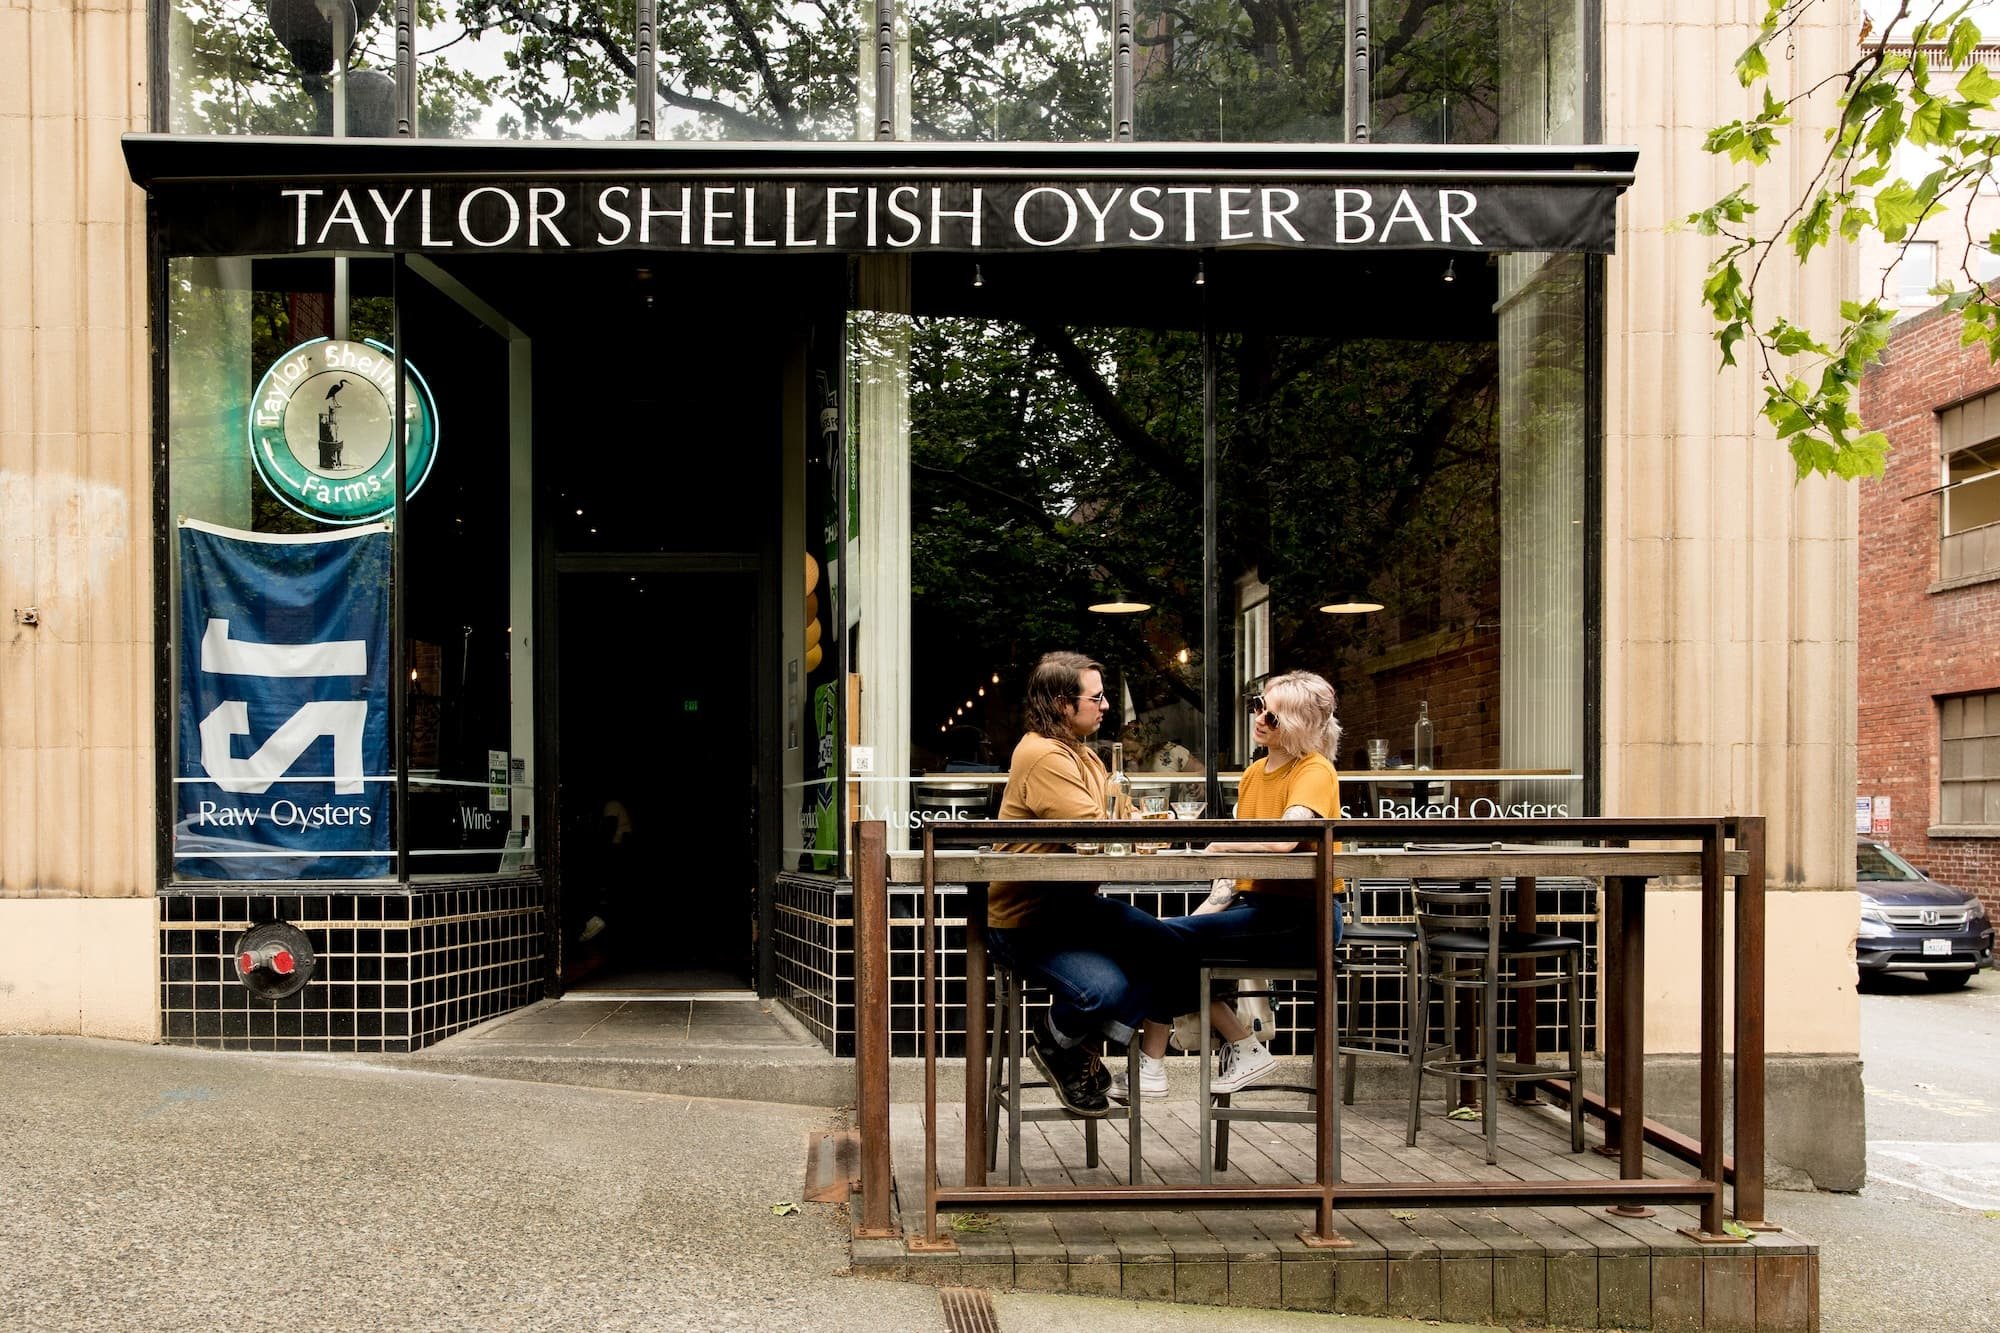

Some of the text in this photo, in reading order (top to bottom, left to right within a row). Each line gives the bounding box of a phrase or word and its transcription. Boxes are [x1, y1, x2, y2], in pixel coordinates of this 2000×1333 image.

[281, 186, 1484, 247] TAYLOR SHELLFISH OYSTER BAR
[257, 353, 309, 428] Taylor
[302, 474, 382, 504] Farms
[200, 799, 372, 834] Raw Oysters
[461, 806, 492, 830] Wine
[853, 803, 969, 829] Mussels
[1378, 798, 1459, 820] Baked
[1469, 797, 1569, 820] Oysters
